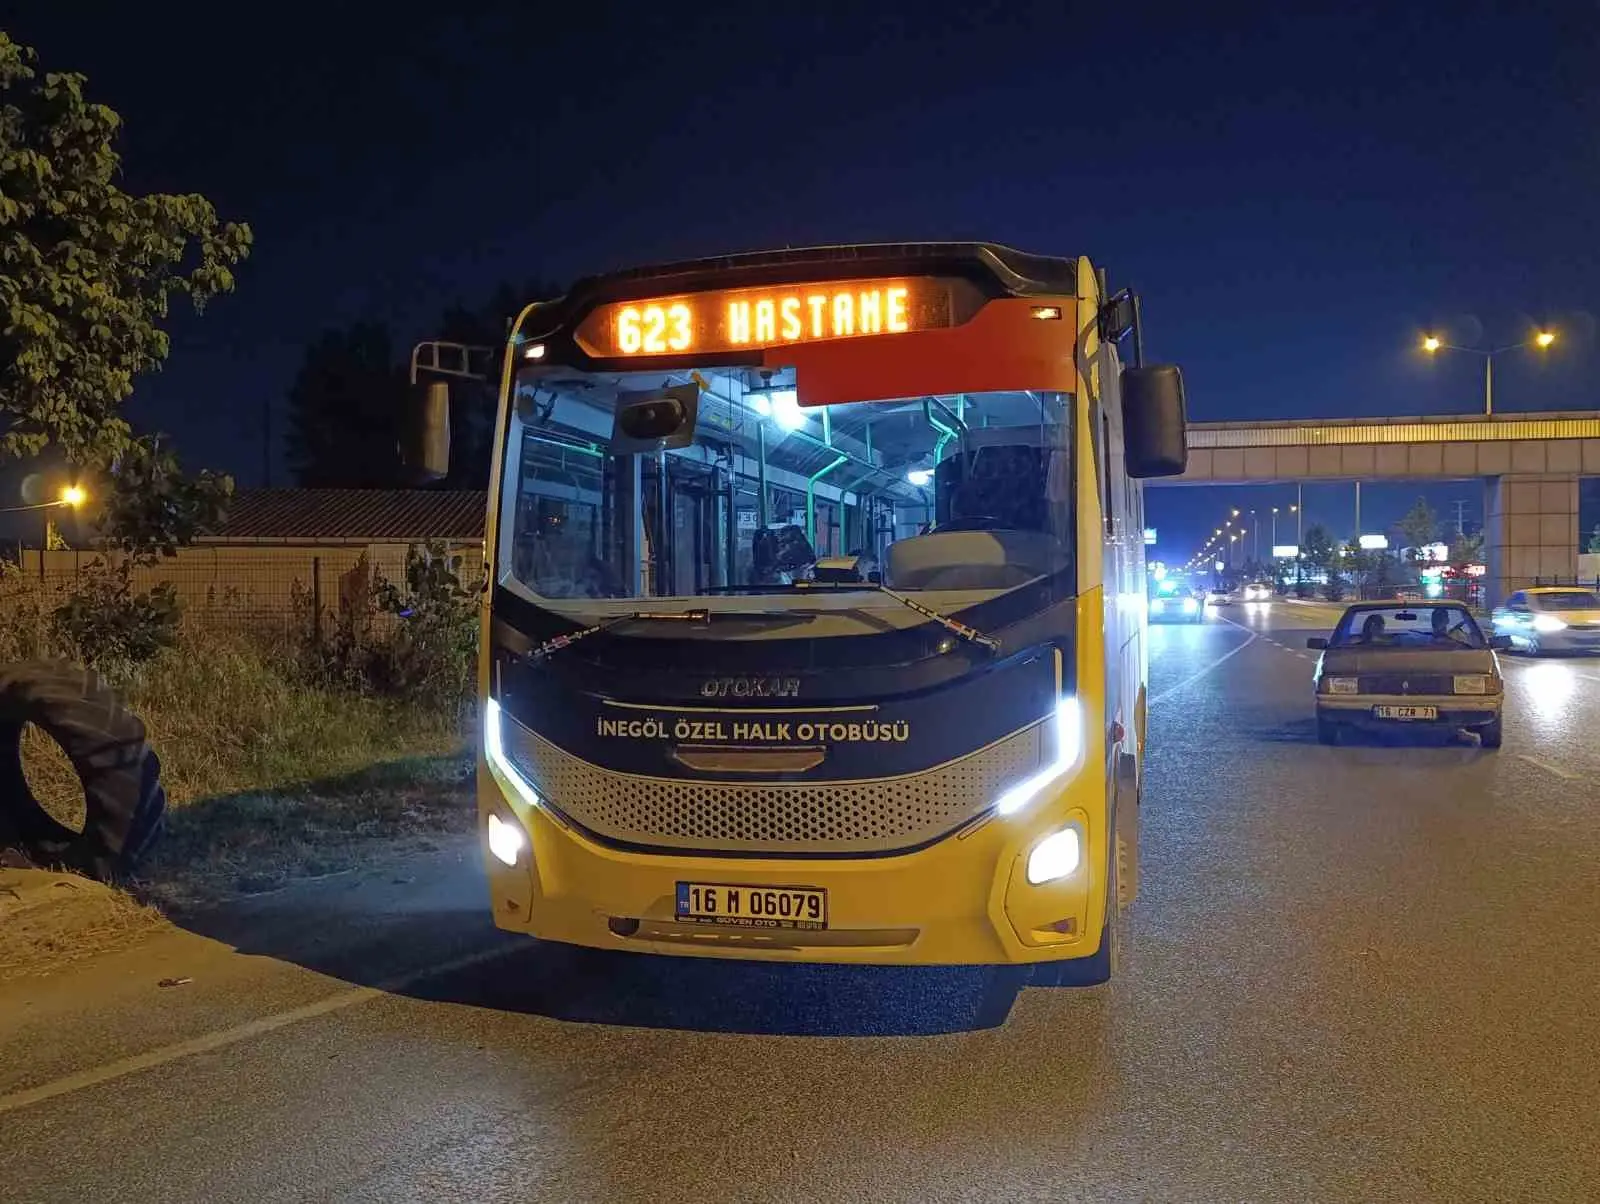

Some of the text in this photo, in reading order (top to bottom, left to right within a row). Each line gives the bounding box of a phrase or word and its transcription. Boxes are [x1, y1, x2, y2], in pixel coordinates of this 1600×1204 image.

[617, 303, 693, 354] 623
[597, 717, 909, 742] İNEGÖL ÖZEL HALK OTOBÜSÜ
[692, 888, 717, 913] 16
[727, 890, 740, 914] M
[750, 892, 820, 918] 06079
